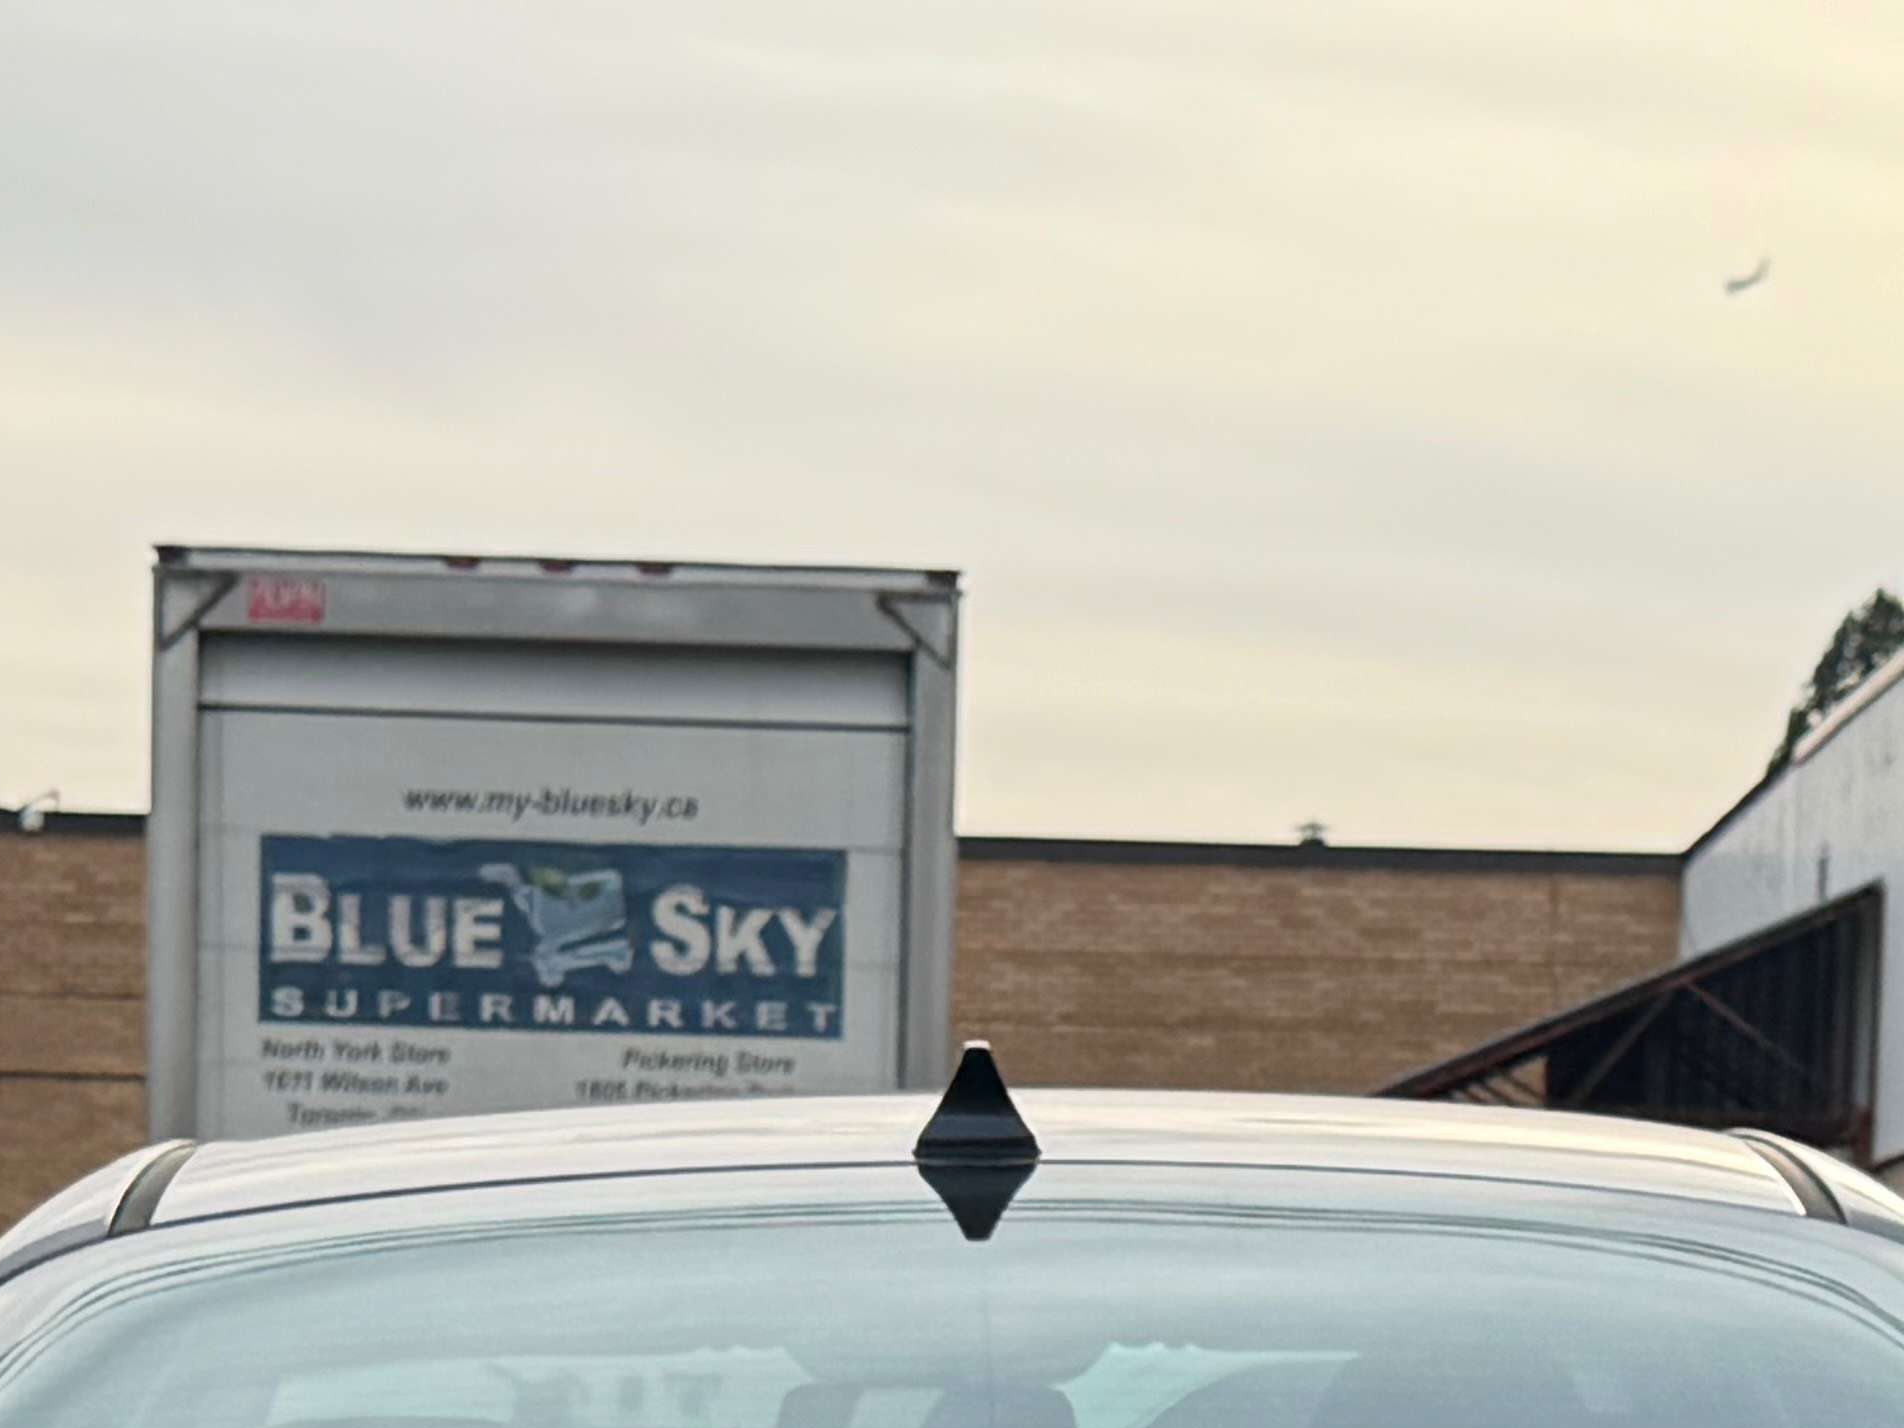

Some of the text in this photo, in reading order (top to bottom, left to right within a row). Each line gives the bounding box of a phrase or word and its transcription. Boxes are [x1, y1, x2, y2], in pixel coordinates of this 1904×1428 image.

[403, 789, 699, 826] www.my-bluesky.ca
[269, 871, 838, 977] BLUE SKY
[269, 987, 840, 1034] SUPERMARKET
[261, 1039, 450, 1065] North York Store
[623, 1048, 794, 1077] Pickering Store
